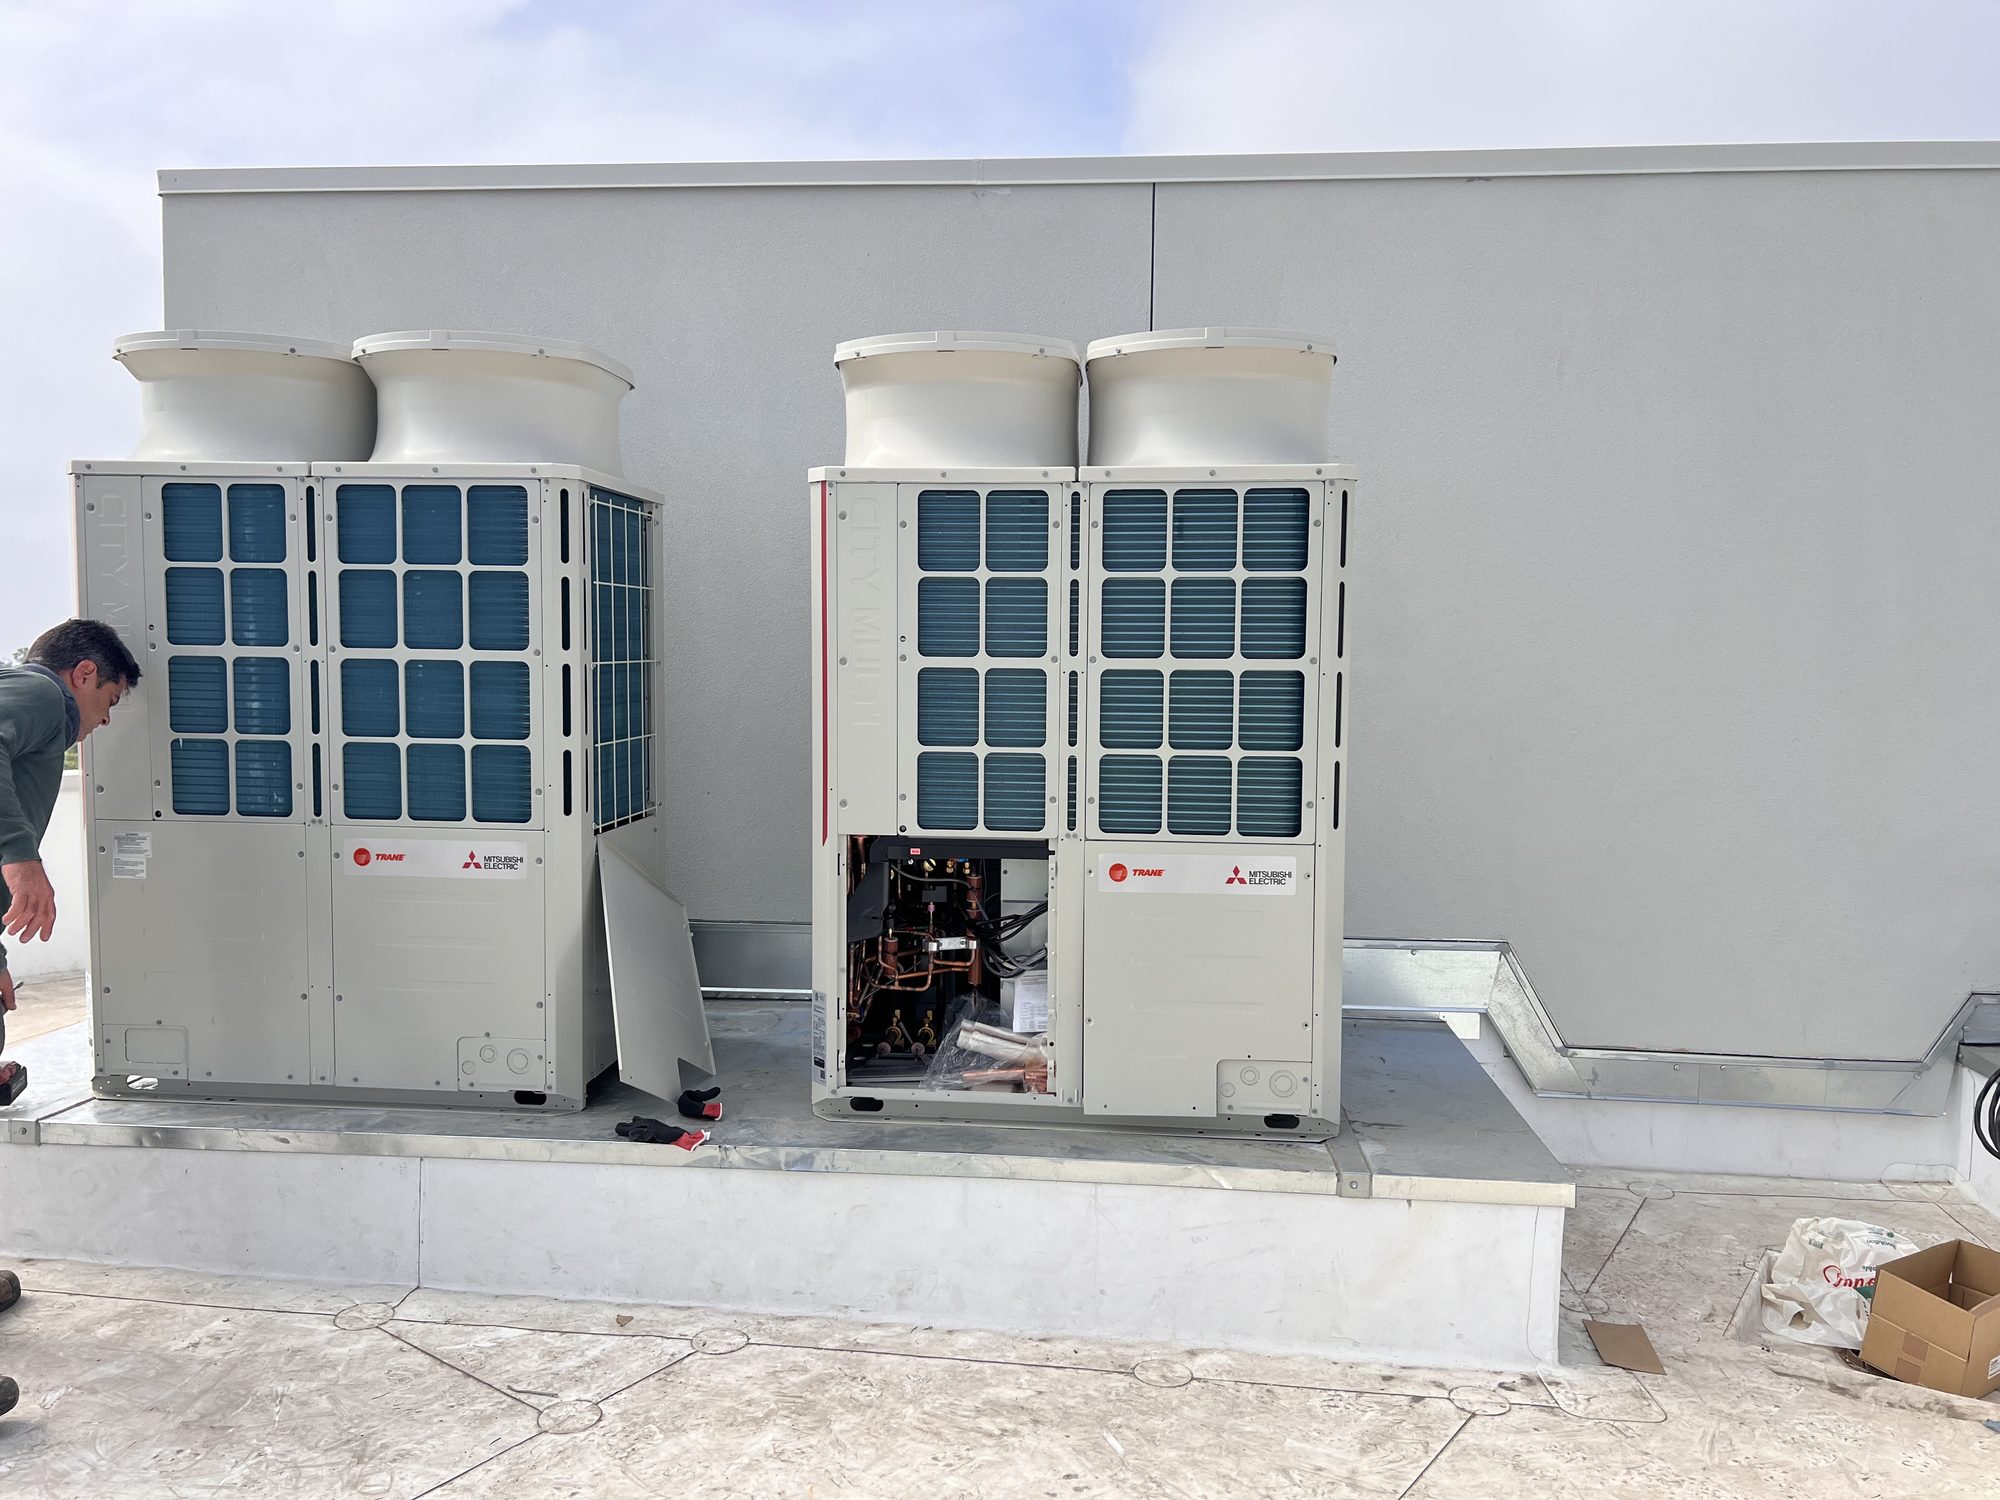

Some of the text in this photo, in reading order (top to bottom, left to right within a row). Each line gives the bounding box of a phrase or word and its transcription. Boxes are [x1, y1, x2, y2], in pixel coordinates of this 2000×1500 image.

[97, 493, 129, 586] CITY
[850, 497, 882, 727] CITY MULTI
[375, 853, 405, 861] TRANE
[483, 856, 523, 864] MITSUBISHI
